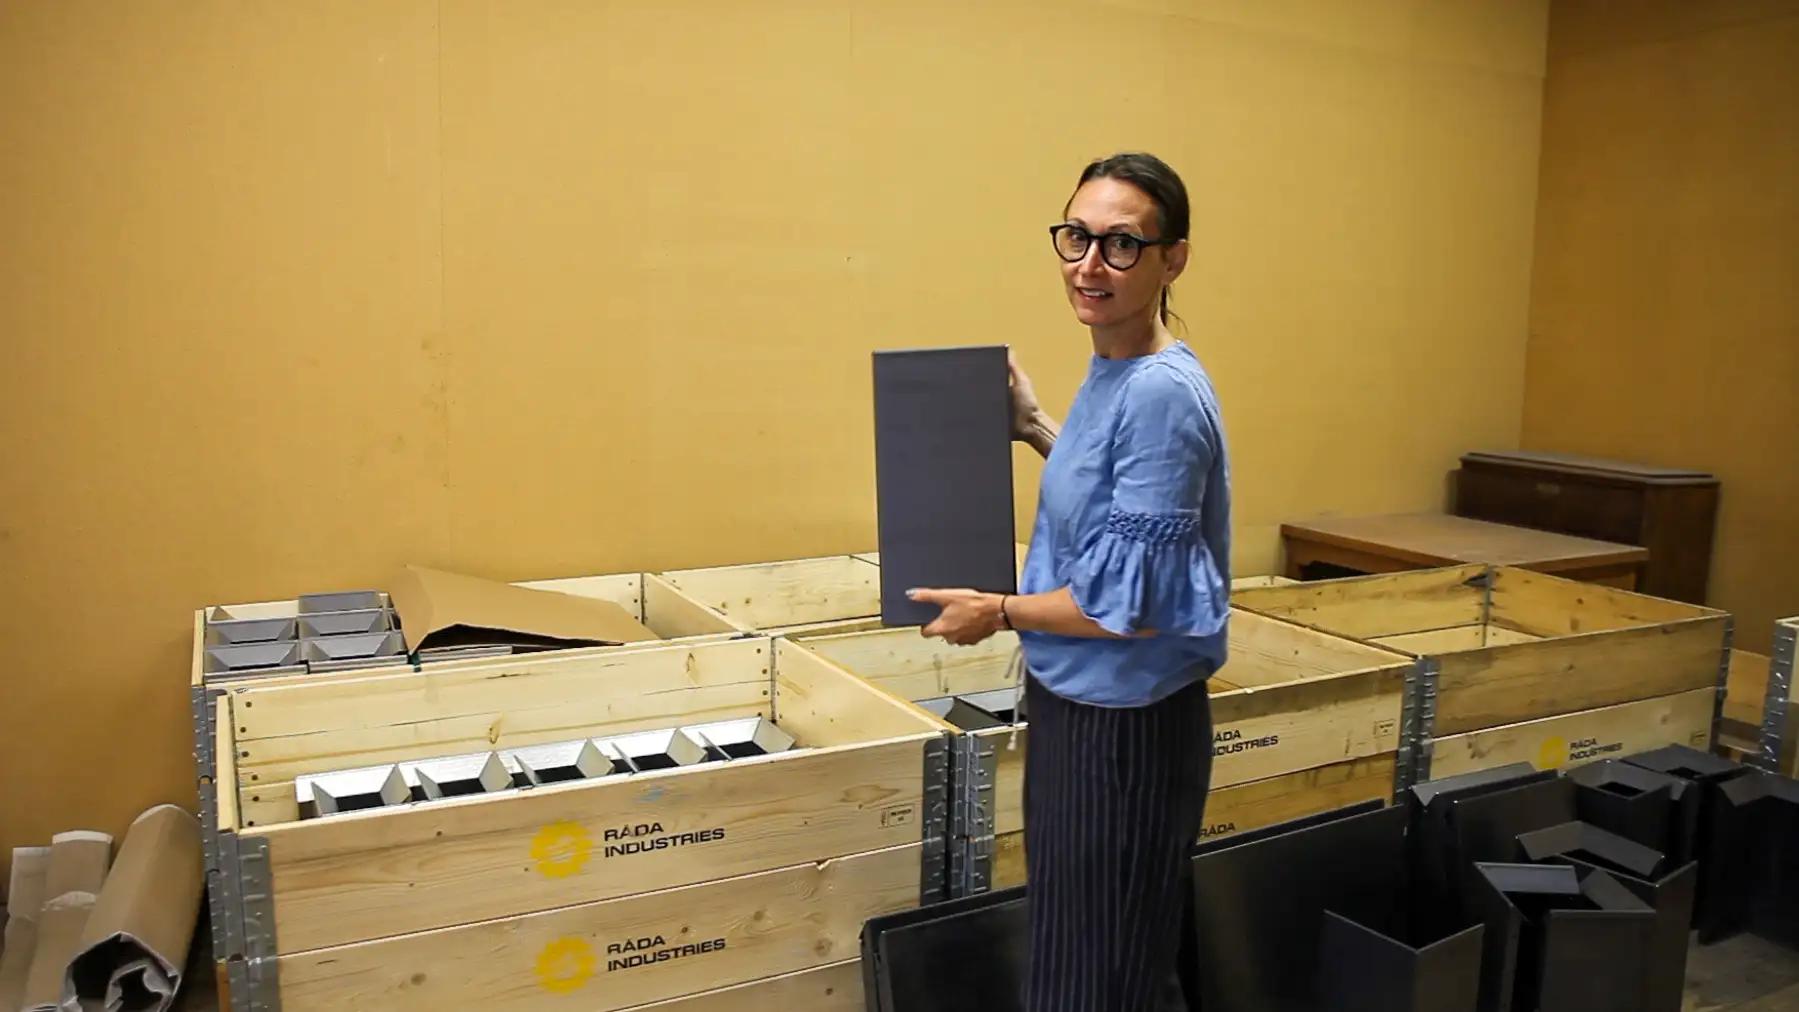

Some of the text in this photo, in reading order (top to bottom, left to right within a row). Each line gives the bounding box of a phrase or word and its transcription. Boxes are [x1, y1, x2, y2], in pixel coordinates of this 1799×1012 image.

[1212, 735, 1279, 757] DUSTRIES
[605, 828, 725, 858] INDUSTRIES
[608, 938, 726, 972] INDUSTRIES
